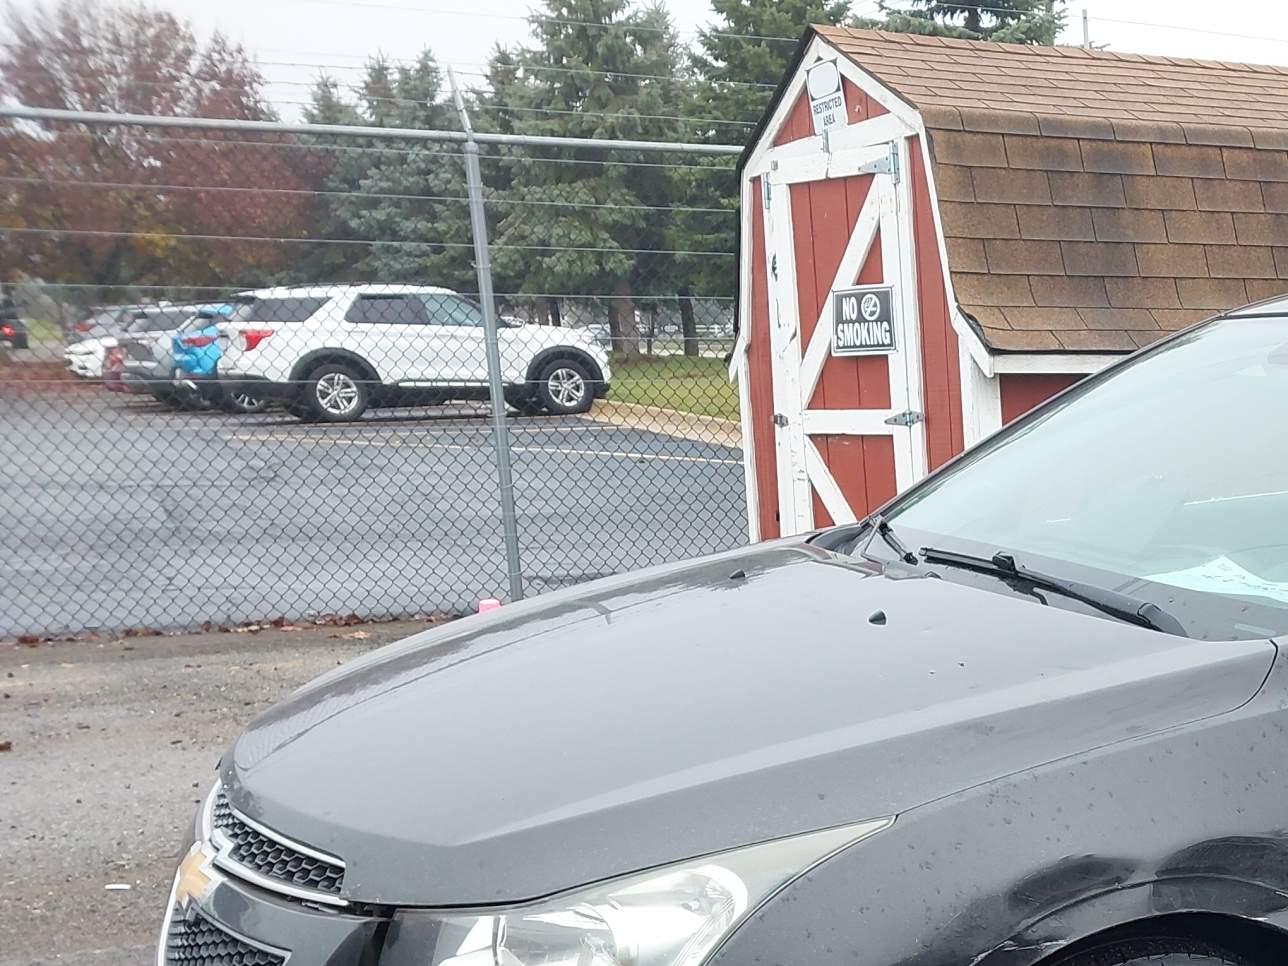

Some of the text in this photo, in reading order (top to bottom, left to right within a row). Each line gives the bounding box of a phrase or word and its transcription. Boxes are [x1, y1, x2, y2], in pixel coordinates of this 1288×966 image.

[813, 96, 842, 114] RESTRICTED
[823, 113, 836, 126] AREA
[842, 296, 858, 321] NO
[837, 321, 891, 347] SMOKING
